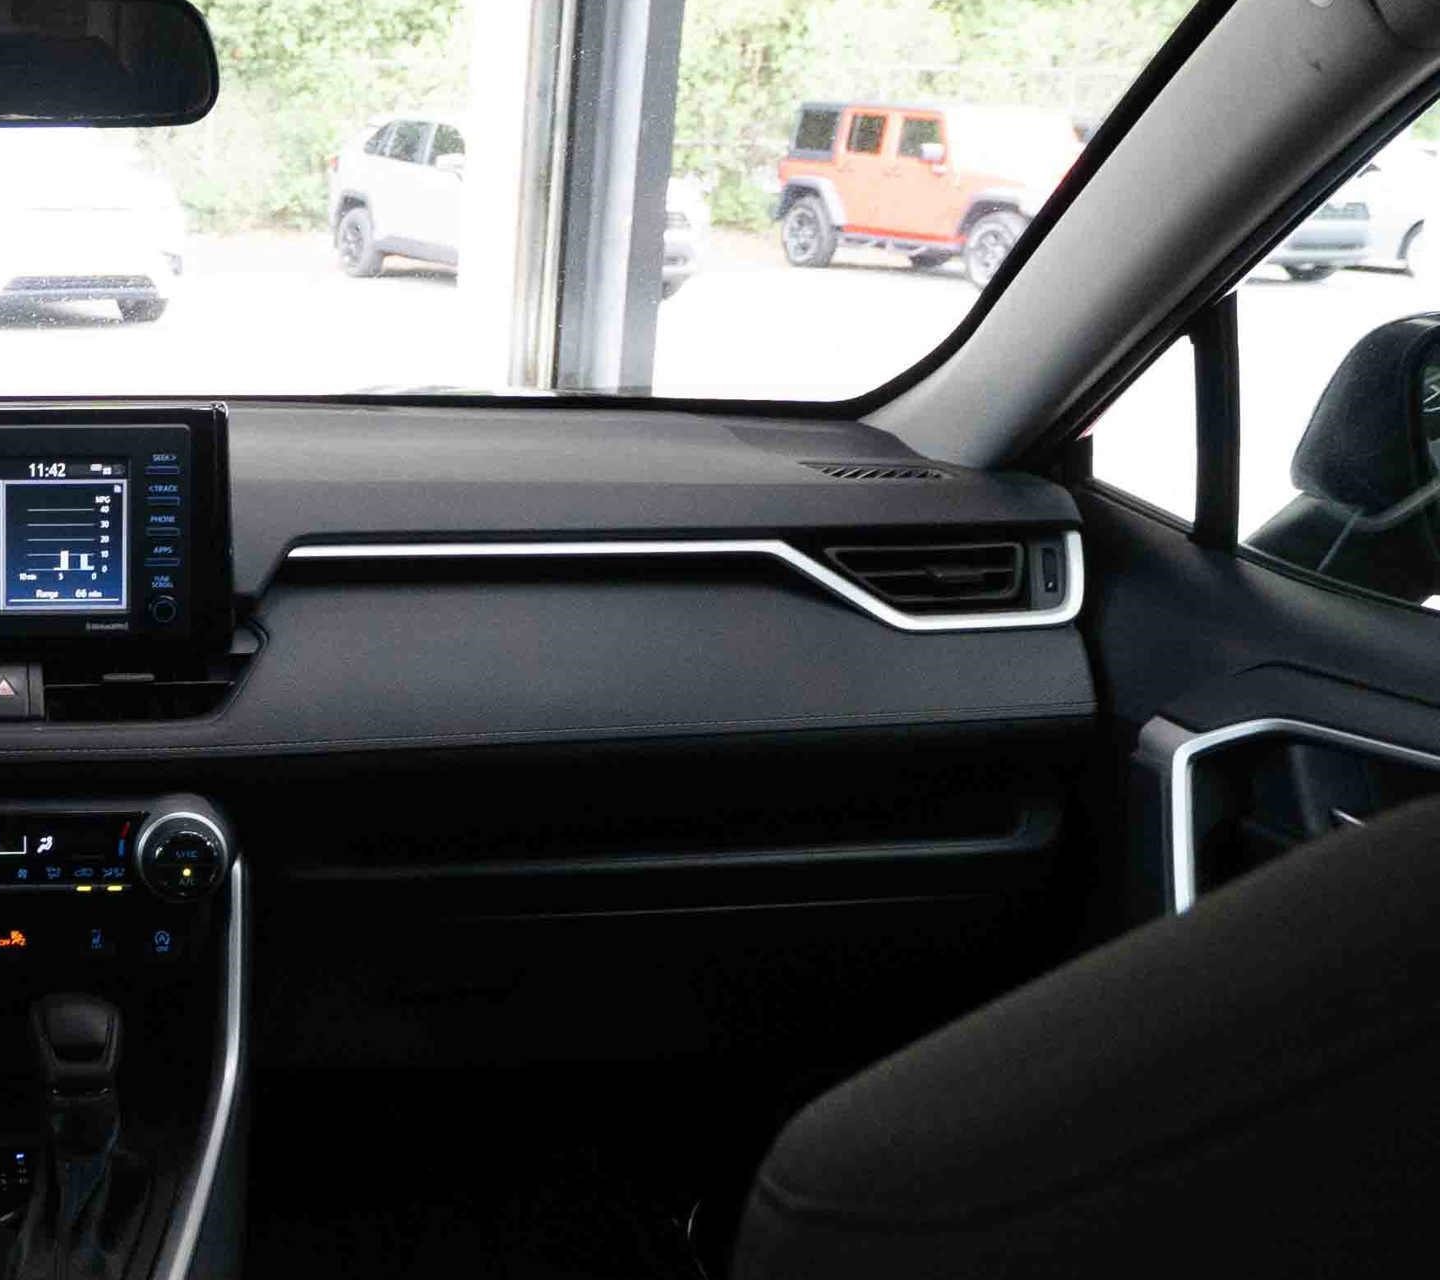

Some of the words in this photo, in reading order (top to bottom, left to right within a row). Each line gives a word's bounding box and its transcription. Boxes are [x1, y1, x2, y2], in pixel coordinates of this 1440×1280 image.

[28, 463, 67, 478] 11:42
[95, 496, 111, 504] MPG
[100, 506, 110, 514] 40
[150, 515, 176, 523] PHONE
[100, 521, 110, 529] 30
[100, 536, 110, 544] 20
[100, 550, 110, 558] 10
[153, 546, 173, 554] APPS
[36, 589, 59, 600] Range
[75, 589, 88, 598] 66
